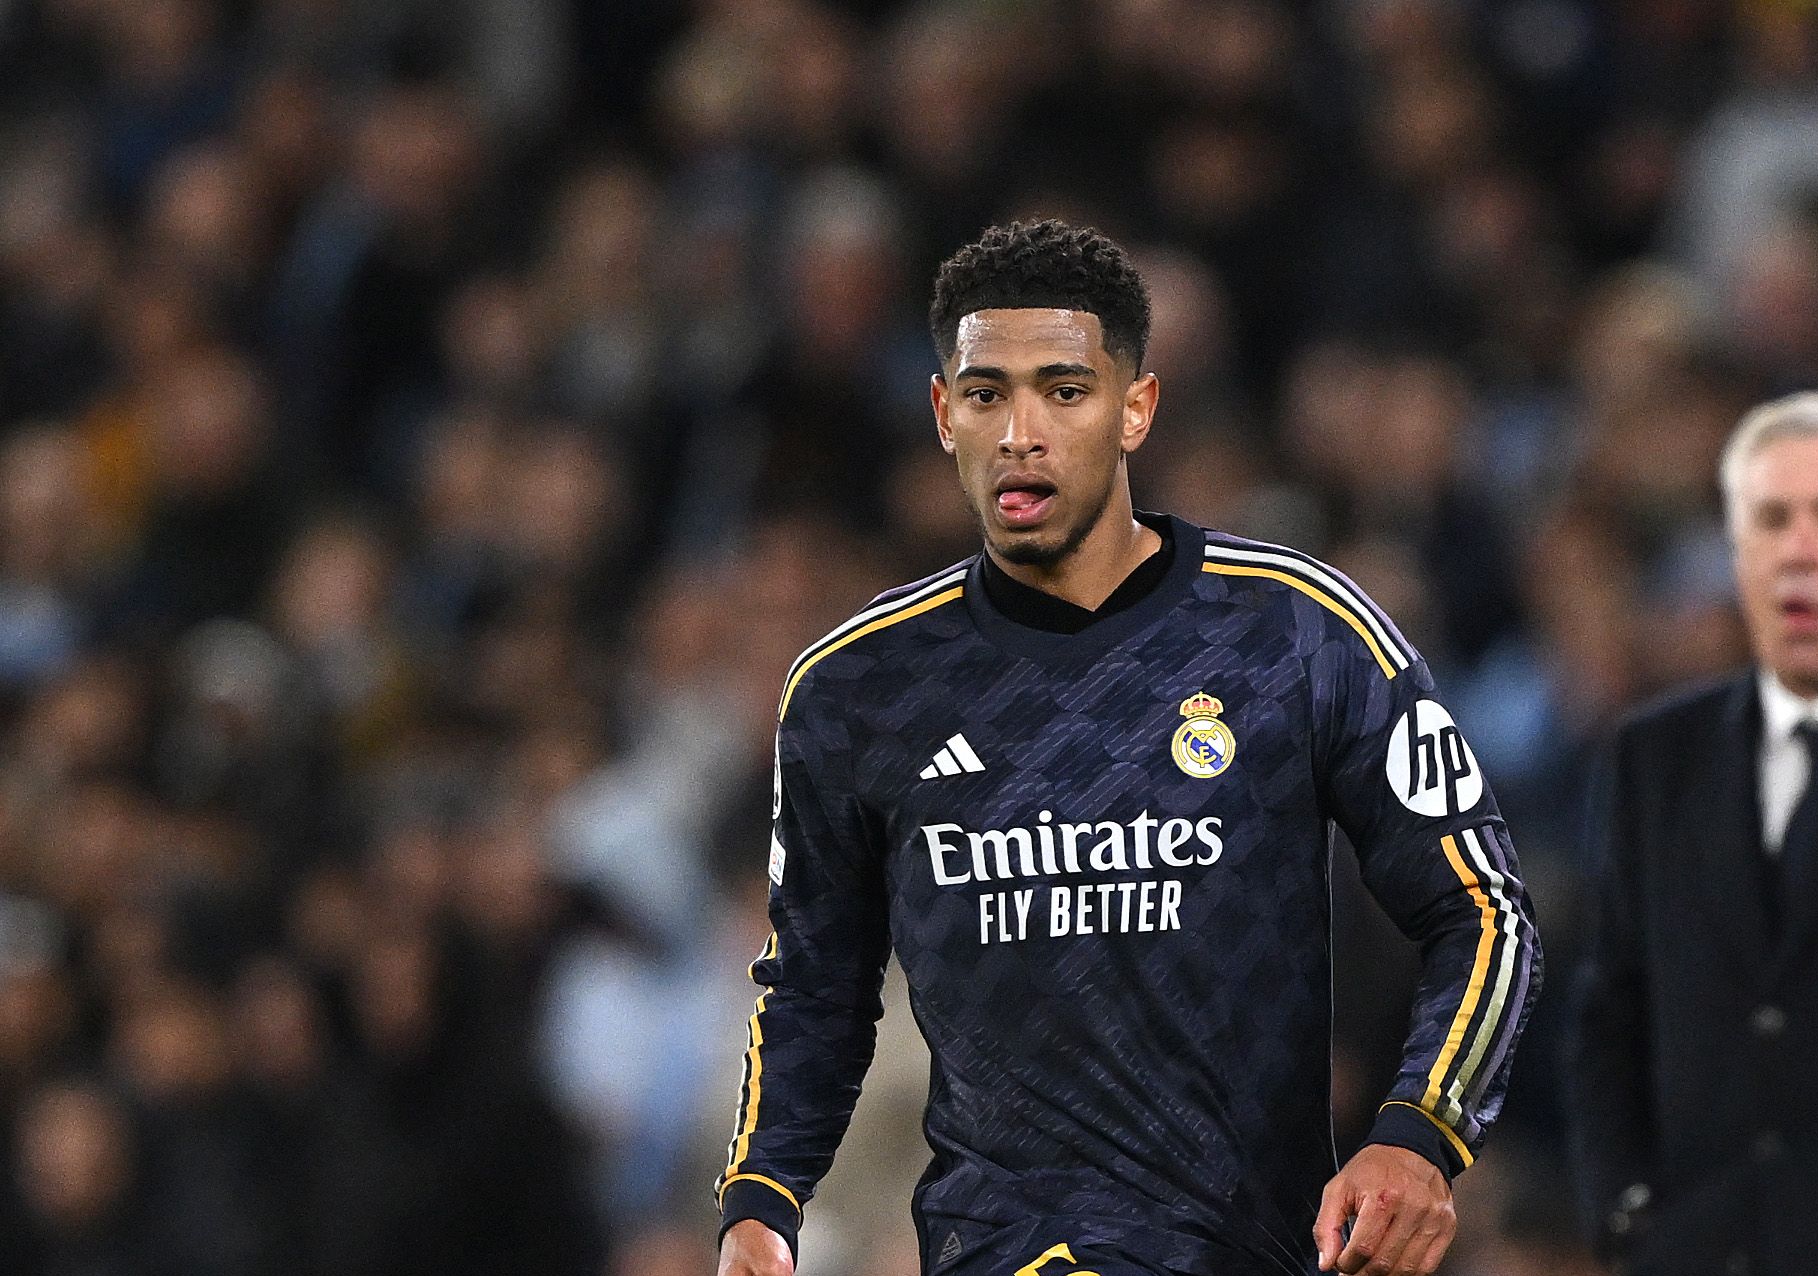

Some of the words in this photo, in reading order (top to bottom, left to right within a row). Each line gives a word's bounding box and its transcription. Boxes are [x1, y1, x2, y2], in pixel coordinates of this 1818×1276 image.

[1407, 700, 1471, 817] hp
[920, 808, 1223, 887] Emirates
[980, 887, 1034, 945] FLY
[1049, 880, 1182, 938] BETTER
